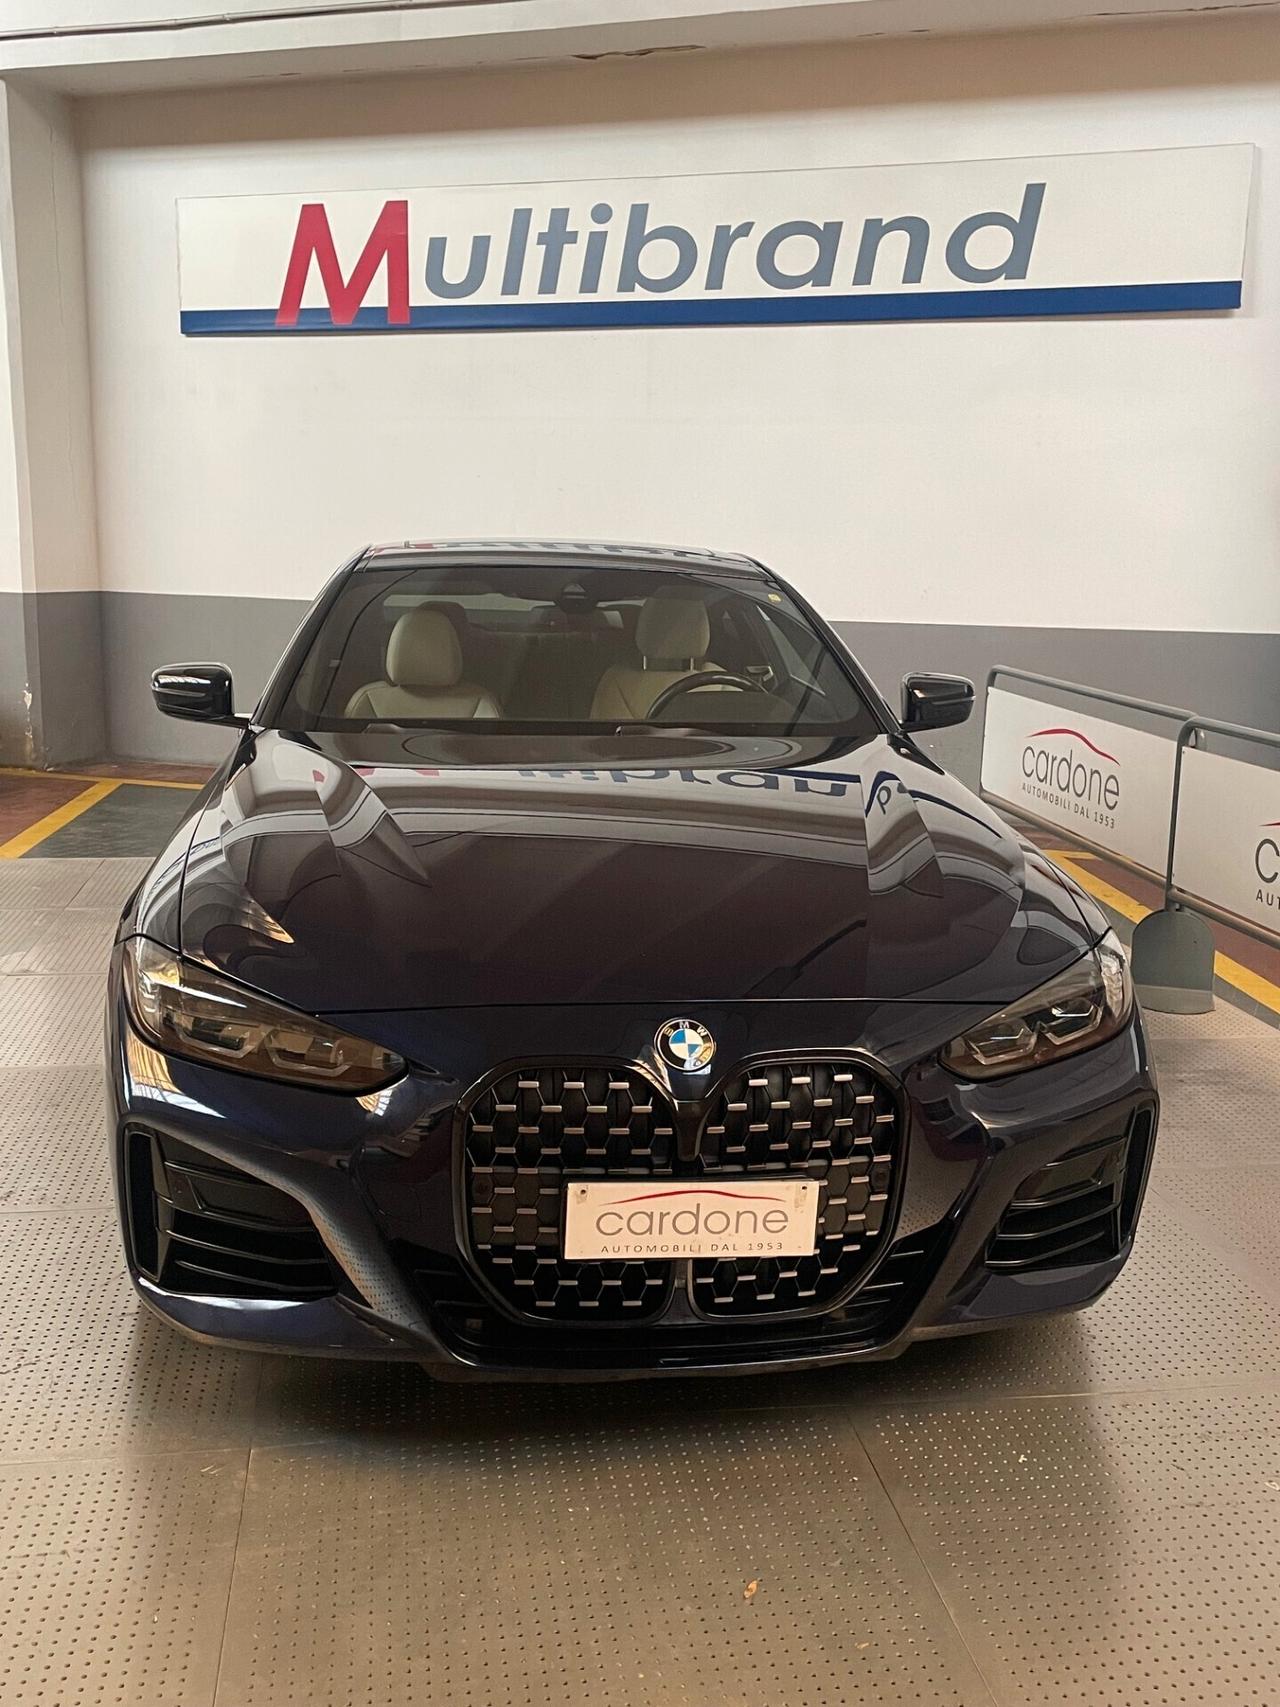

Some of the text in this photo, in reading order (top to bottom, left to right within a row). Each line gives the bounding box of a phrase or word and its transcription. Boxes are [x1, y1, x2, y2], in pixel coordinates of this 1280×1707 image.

[276, 182, 1046, 326] Multibrand
[1022, 745, 1120, 811] cardone
[1022, 783, 1115, 829] AUTOMOBILI DAL 1953
[664, 1021, 708, 1037] BMW
[596, 1203, 788, 1236] cardone
[601, 1242, 783, 1253] AUTOMOBILI DAL 1953
